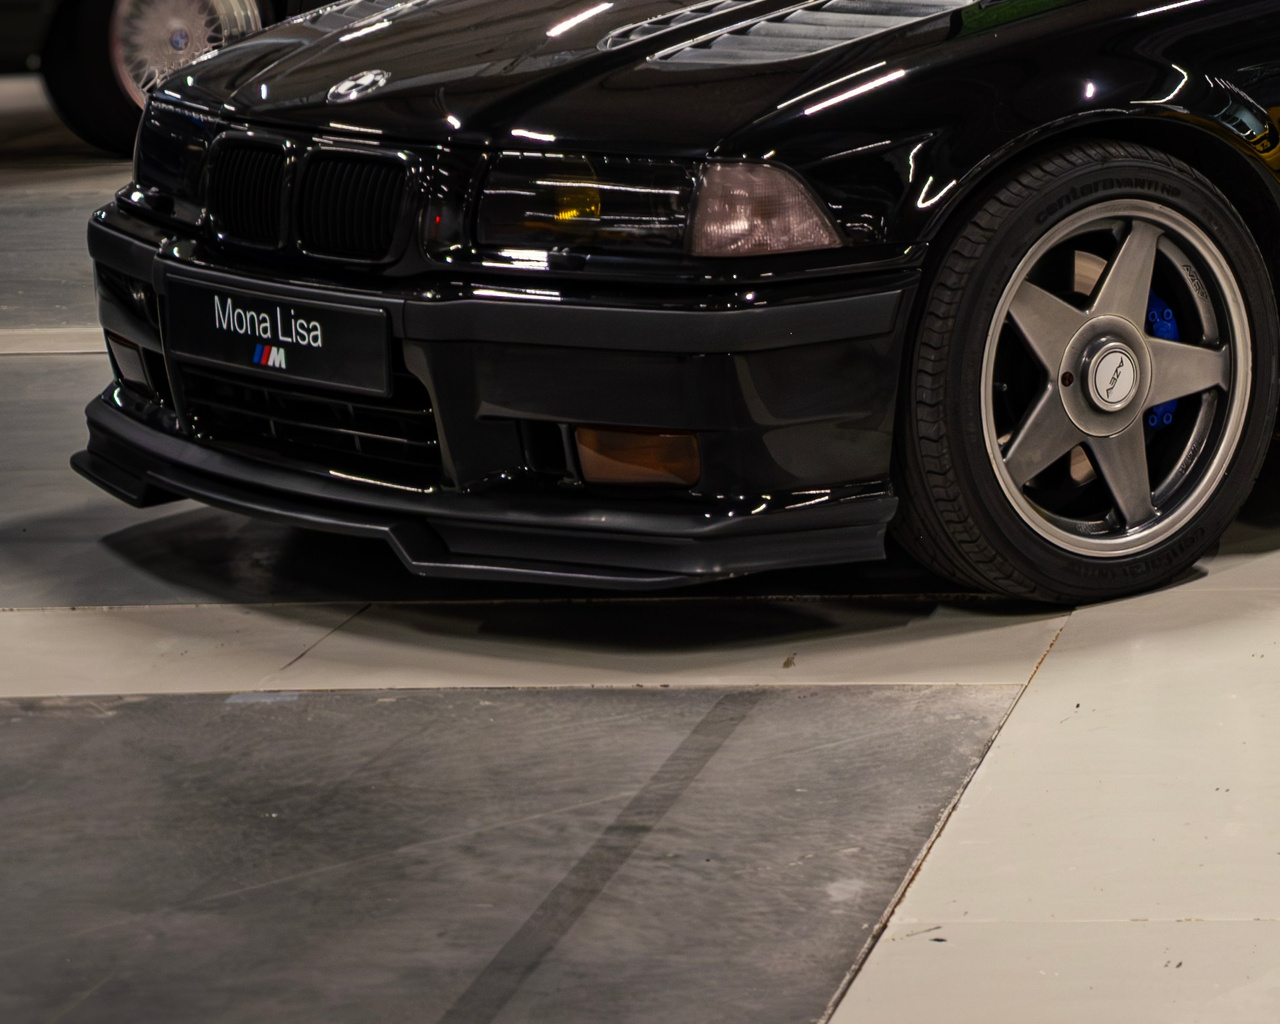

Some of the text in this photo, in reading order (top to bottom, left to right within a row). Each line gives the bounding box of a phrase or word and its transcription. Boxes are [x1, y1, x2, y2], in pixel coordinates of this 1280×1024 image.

[214, 295, 322, 347] Mona Lisa
[1105, 356, 1124, 399] AZEV
